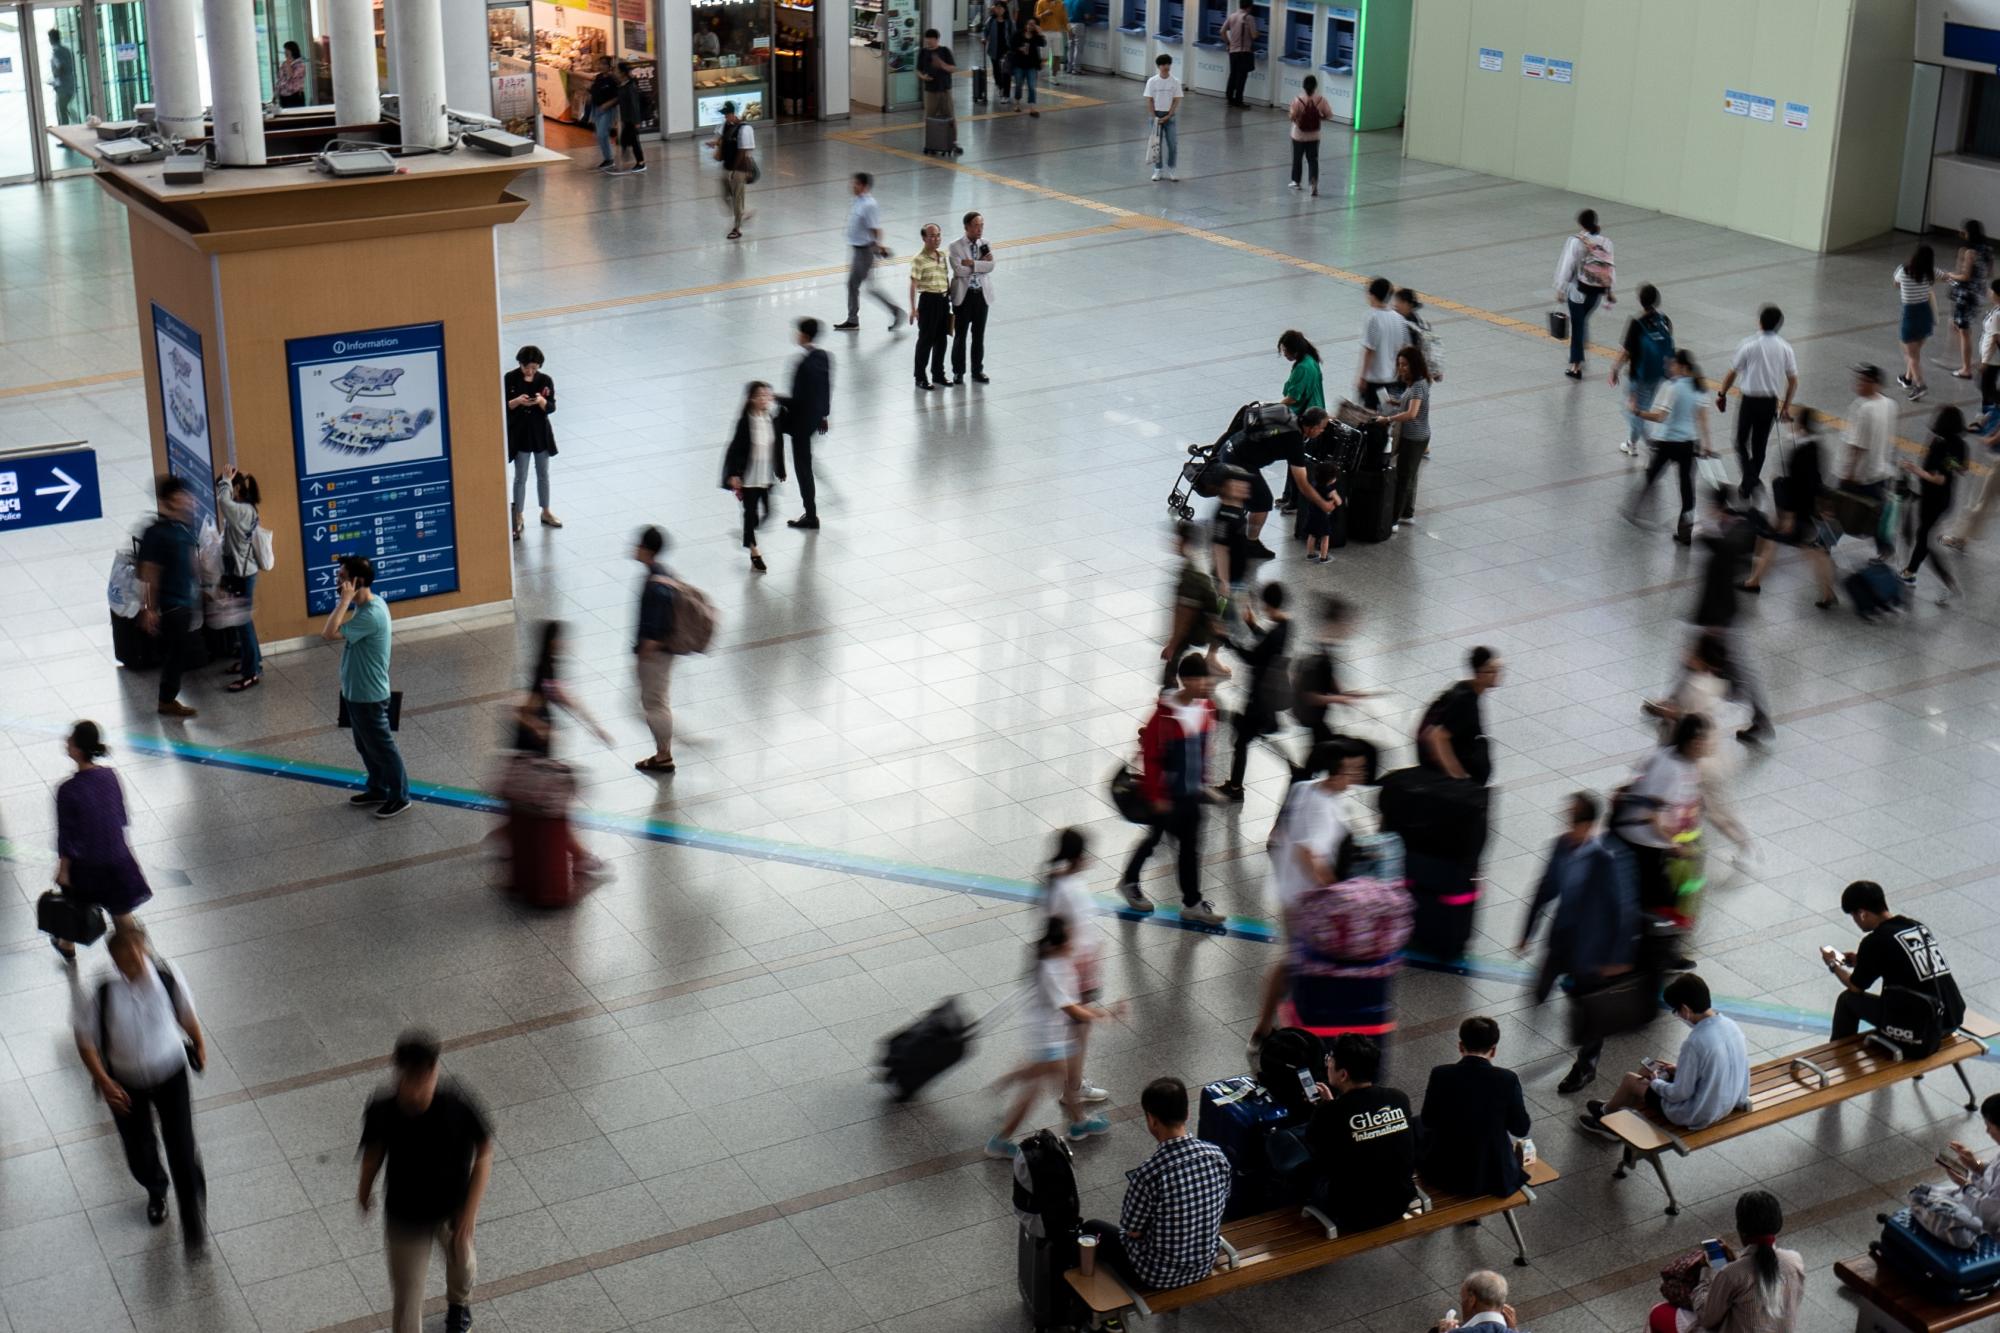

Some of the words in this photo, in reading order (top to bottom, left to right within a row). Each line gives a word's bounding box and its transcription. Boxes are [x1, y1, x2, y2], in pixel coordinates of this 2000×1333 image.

[346, 337, 399, 351] Information
[1886, 1025, 1913, 1041] CDG
[1349, 1107, 1405, 1130] Gleam
[1352, 1119, 1409, 1142] International
